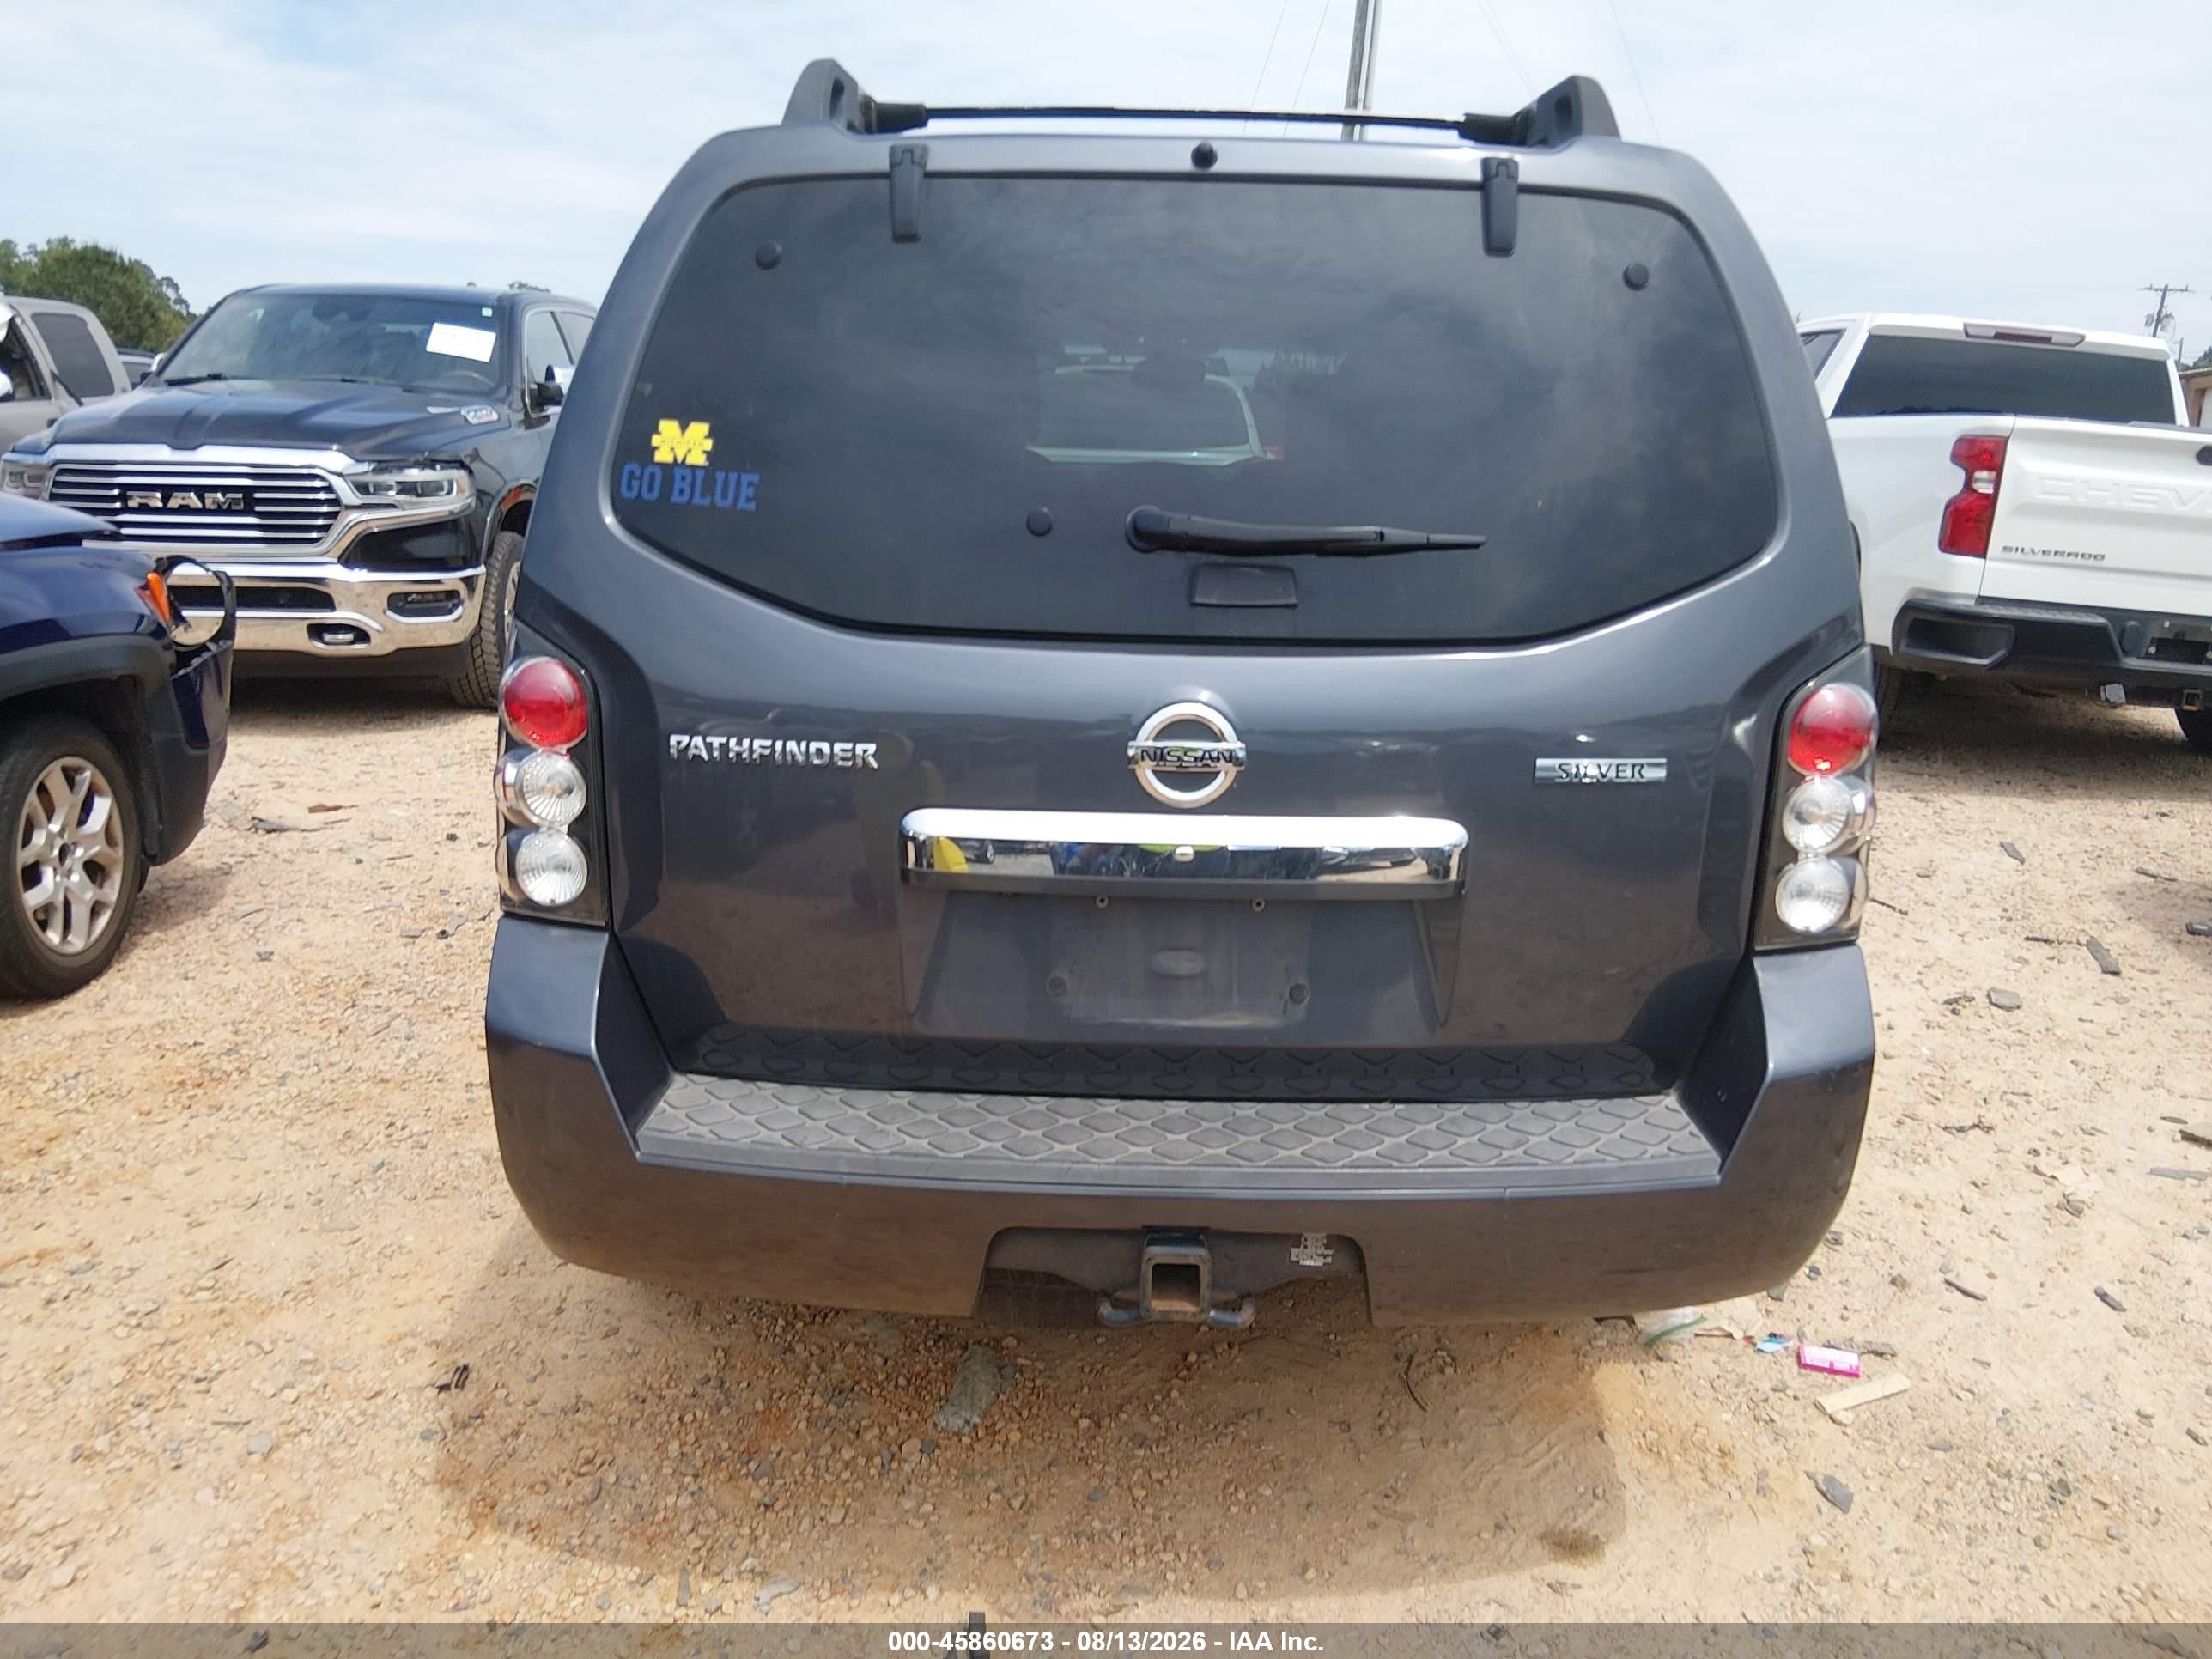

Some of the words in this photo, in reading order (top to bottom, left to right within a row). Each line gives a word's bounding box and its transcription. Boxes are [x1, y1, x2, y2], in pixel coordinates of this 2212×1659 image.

[651, 418, 713, 466] M
[126, 490, 245, 510] RAM
[620, 462, 662, 501] GO
[670, 466, 759, 512] BLUE
[2034, 477, 2212, 513] CHEV
[2002, 545, 2106, 562] SILVERADO
[669, 733, 879, 769] PATHFINDER
[1140, 747, 1234, 764] NISSAN
[1557, 762, 1646, 780] SILVER
